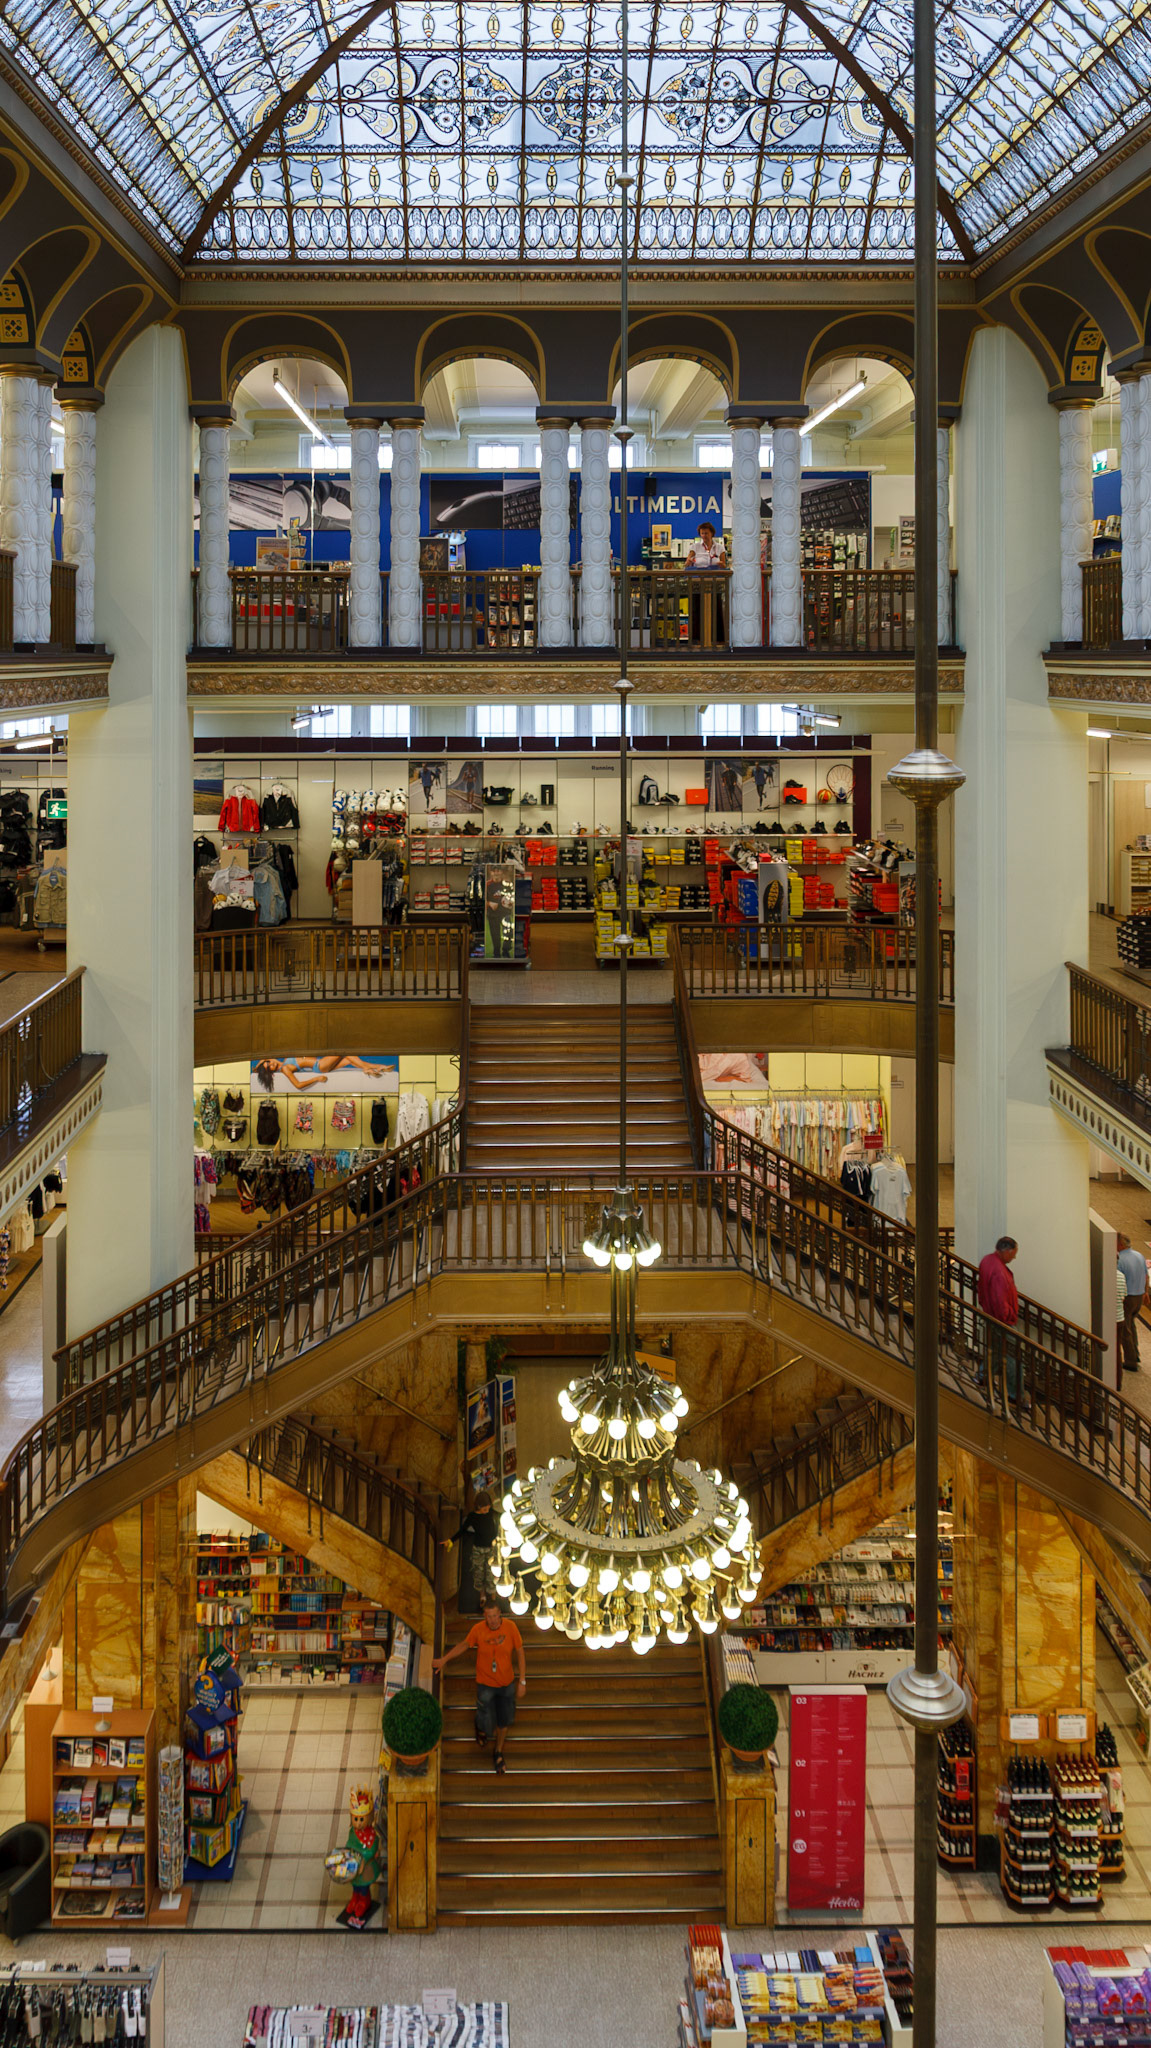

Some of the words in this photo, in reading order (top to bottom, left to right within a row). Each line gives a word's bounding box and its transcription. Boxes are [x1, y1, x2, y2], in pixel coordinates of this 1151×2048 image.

[579, 495, 721, 514] LTIMEDIA
[591, 764, 615, 772] Running
[848, 1669, 885, 1678] HACHEZ
[796, 1696, 807, 1705] 03
[795, 1759, 806, 1768] 02
[794, 1809, 806, 1818] 01
